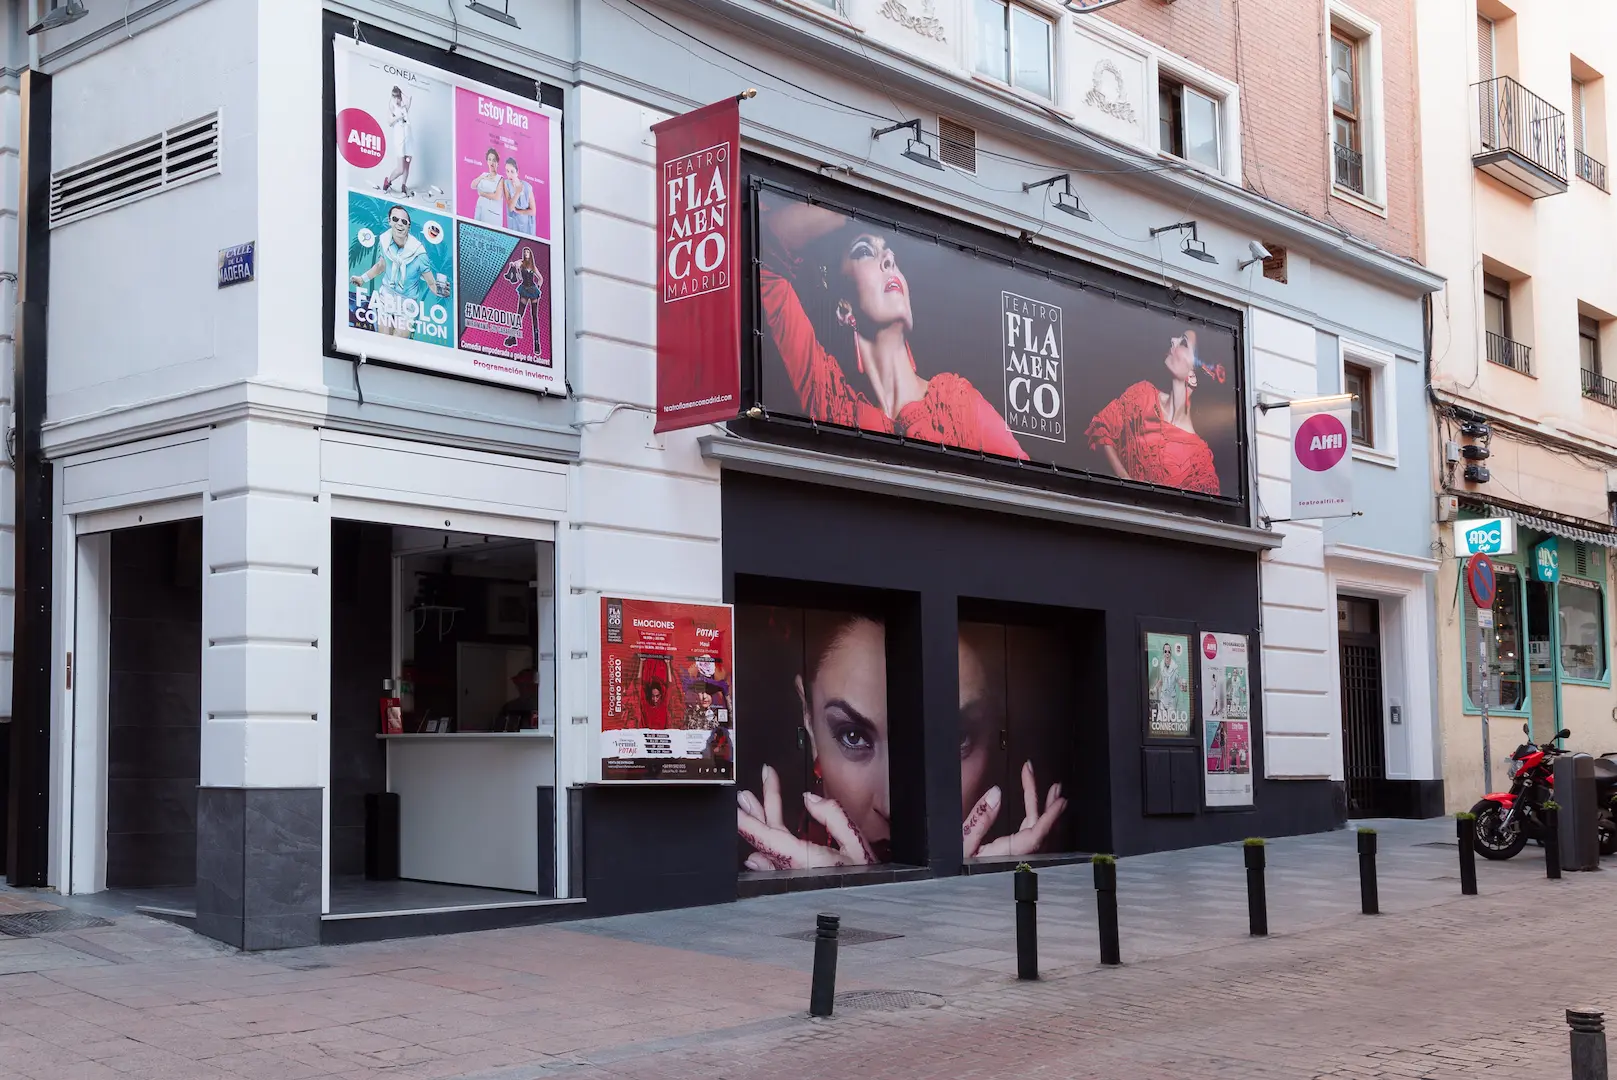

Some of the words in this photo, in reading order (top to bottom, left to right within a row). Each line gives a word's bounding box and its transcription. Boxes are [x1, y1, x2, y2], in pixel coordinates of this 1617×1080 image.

[383, 64, 417, 81] CONEJA
[478, 97, 505, 125] Estoy
[506, 106, 529, 130] Rara
[360, 146, 381, 157] teatro
[667, 148, 727, 178] TEATRO
[667, 165, 727, 217] FLA
[667, 202, 727, 243] MEN
[226, 245, 251, 258] CALLE
[668, 232, 726, 280] CO
[667, 272, 727, 298] MADRID
[355, 286, 448, 325] FABIOLO
[465, 302, 523, 329] #MAZODIVA
[1004, 295, 1058, 322] TEATRO
[355, 308, 448, 339] CONNECTION
[1006, 311, 1060, 359] FLA
[473, 359, 524, 376] Programación
[1006, 350, 1059, 382] MEN
[663, 394, 733, 412] teatroflamencomadrid.com
[1008, 377, 1060, 419] CO
[1009, 411, 1062, 435] MADRID
[1469, 529, 1501, 544] ADC
[1538, 547, 1558, 568] ADC
[609, 607, 621, 615] FLA
[633, 618, 675, 630] EMOCIONES
[695, 627, 719, 641] POTAJE
[614, 659, 622, 683] 2020
[614, 685, 622, 713] Enero
[1151, 709, 1188, 722] FABIOLO
[1151, 722, 1188, 731] CONNECTION
